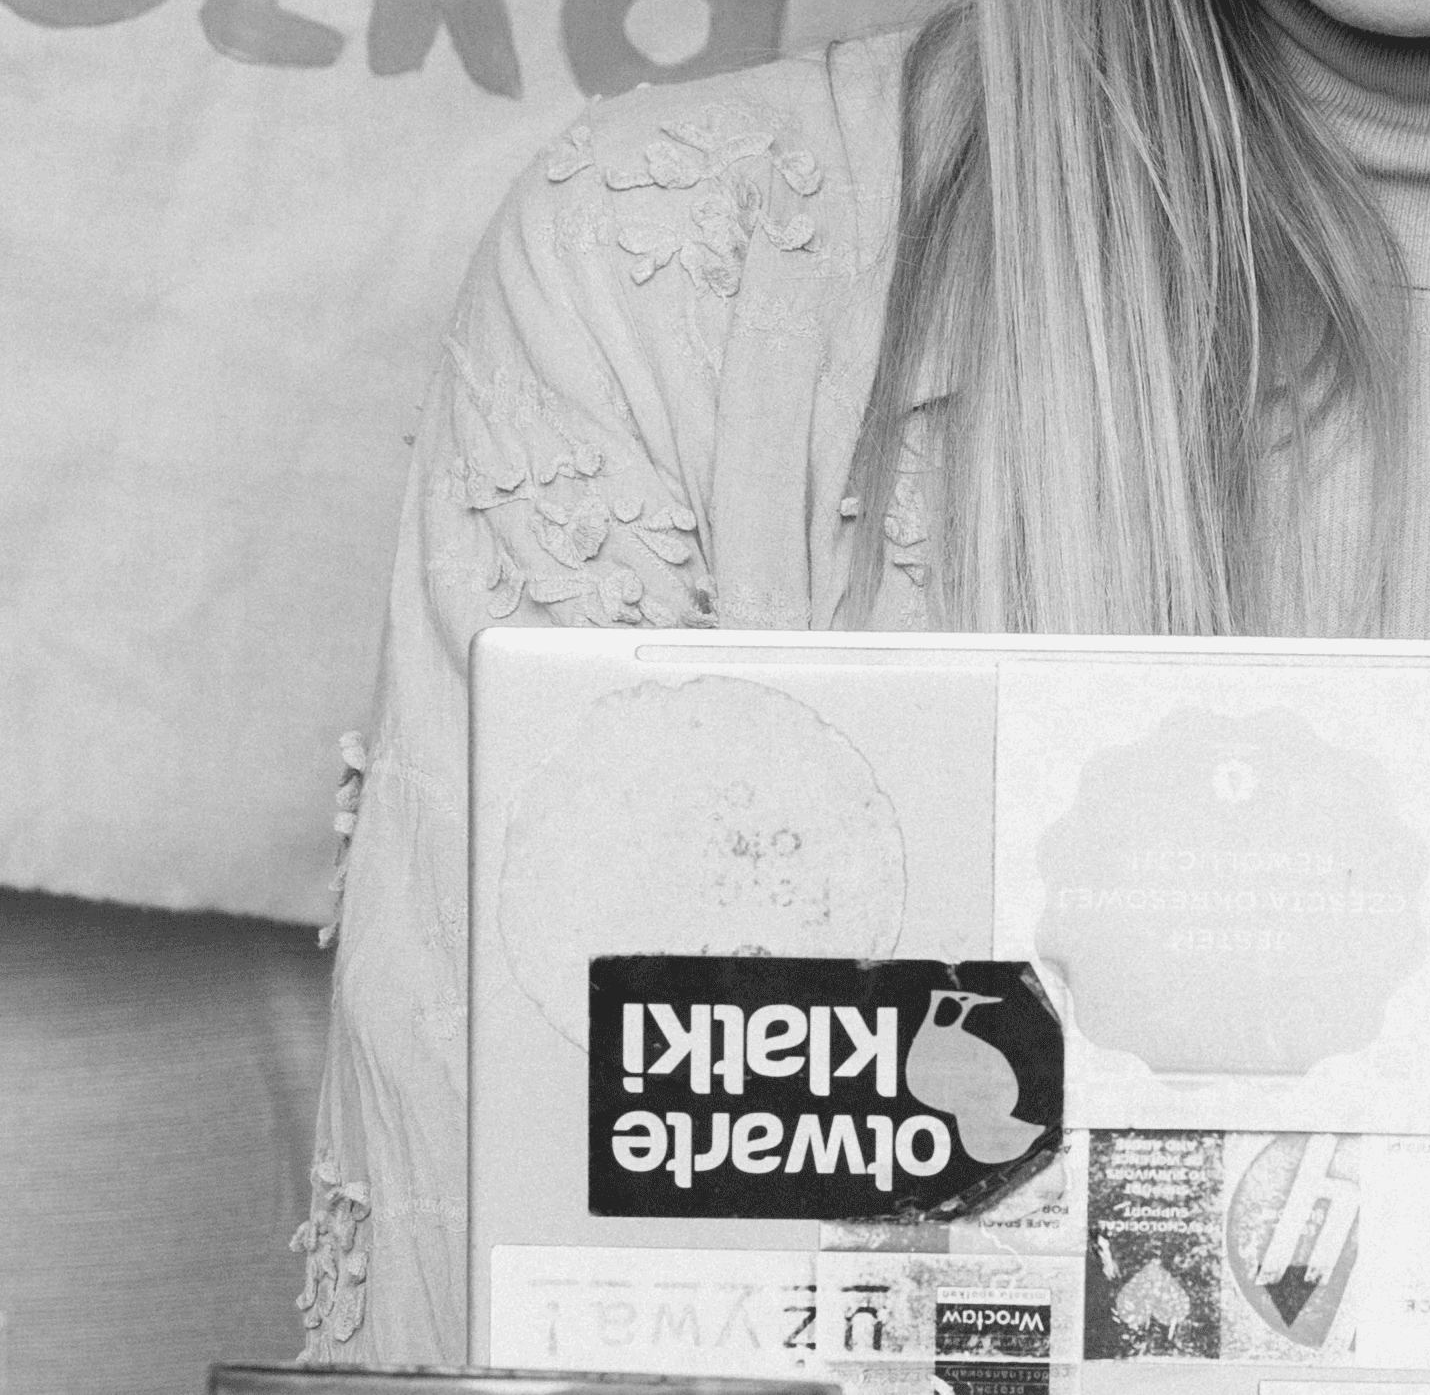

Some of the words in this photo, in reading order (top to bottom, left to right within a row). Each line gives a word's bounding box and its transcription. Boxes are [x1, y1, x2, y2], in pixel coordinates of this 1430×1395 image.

[621, 1001, 897, 1097] klatki
[610, 1109, 951, 1191] otwarte
[1121, 1205, 1188, 1217] SUPPORT
[940, 1308, 1044, 1331] Wrocław
